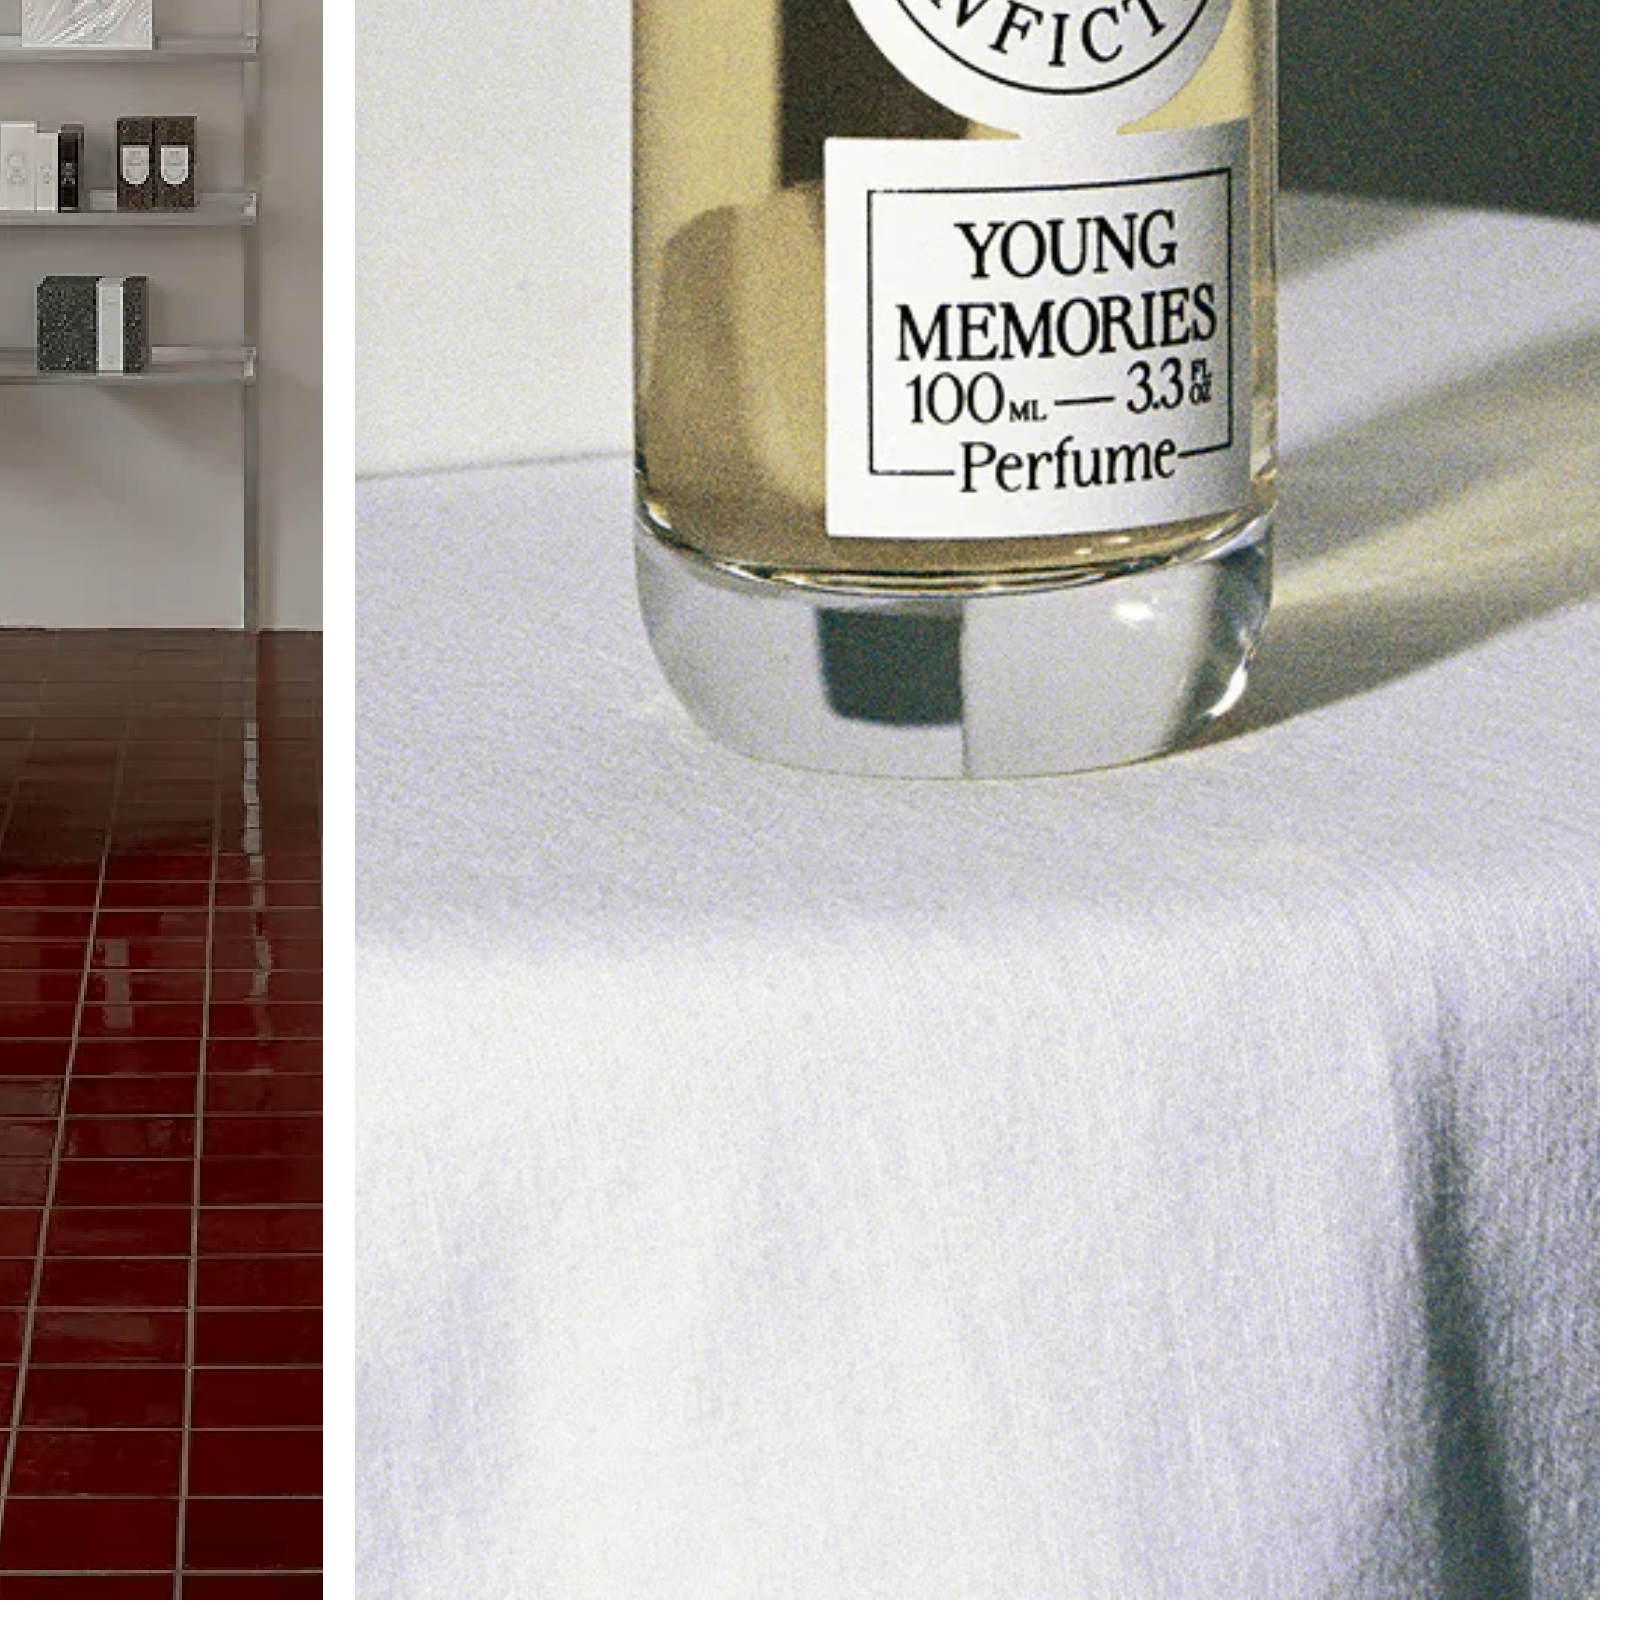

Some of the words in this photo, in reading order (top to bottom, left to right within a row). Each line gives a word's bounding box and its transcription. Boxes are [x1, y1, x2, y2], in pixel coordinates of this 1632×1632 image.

[953, 209, 1179, 280] YOUNG
[895, 283, 1219, 362] MEMORIES
[1126, 356, 1185, 415] 3.3
[960, 434, 1177, 494] Perfume
